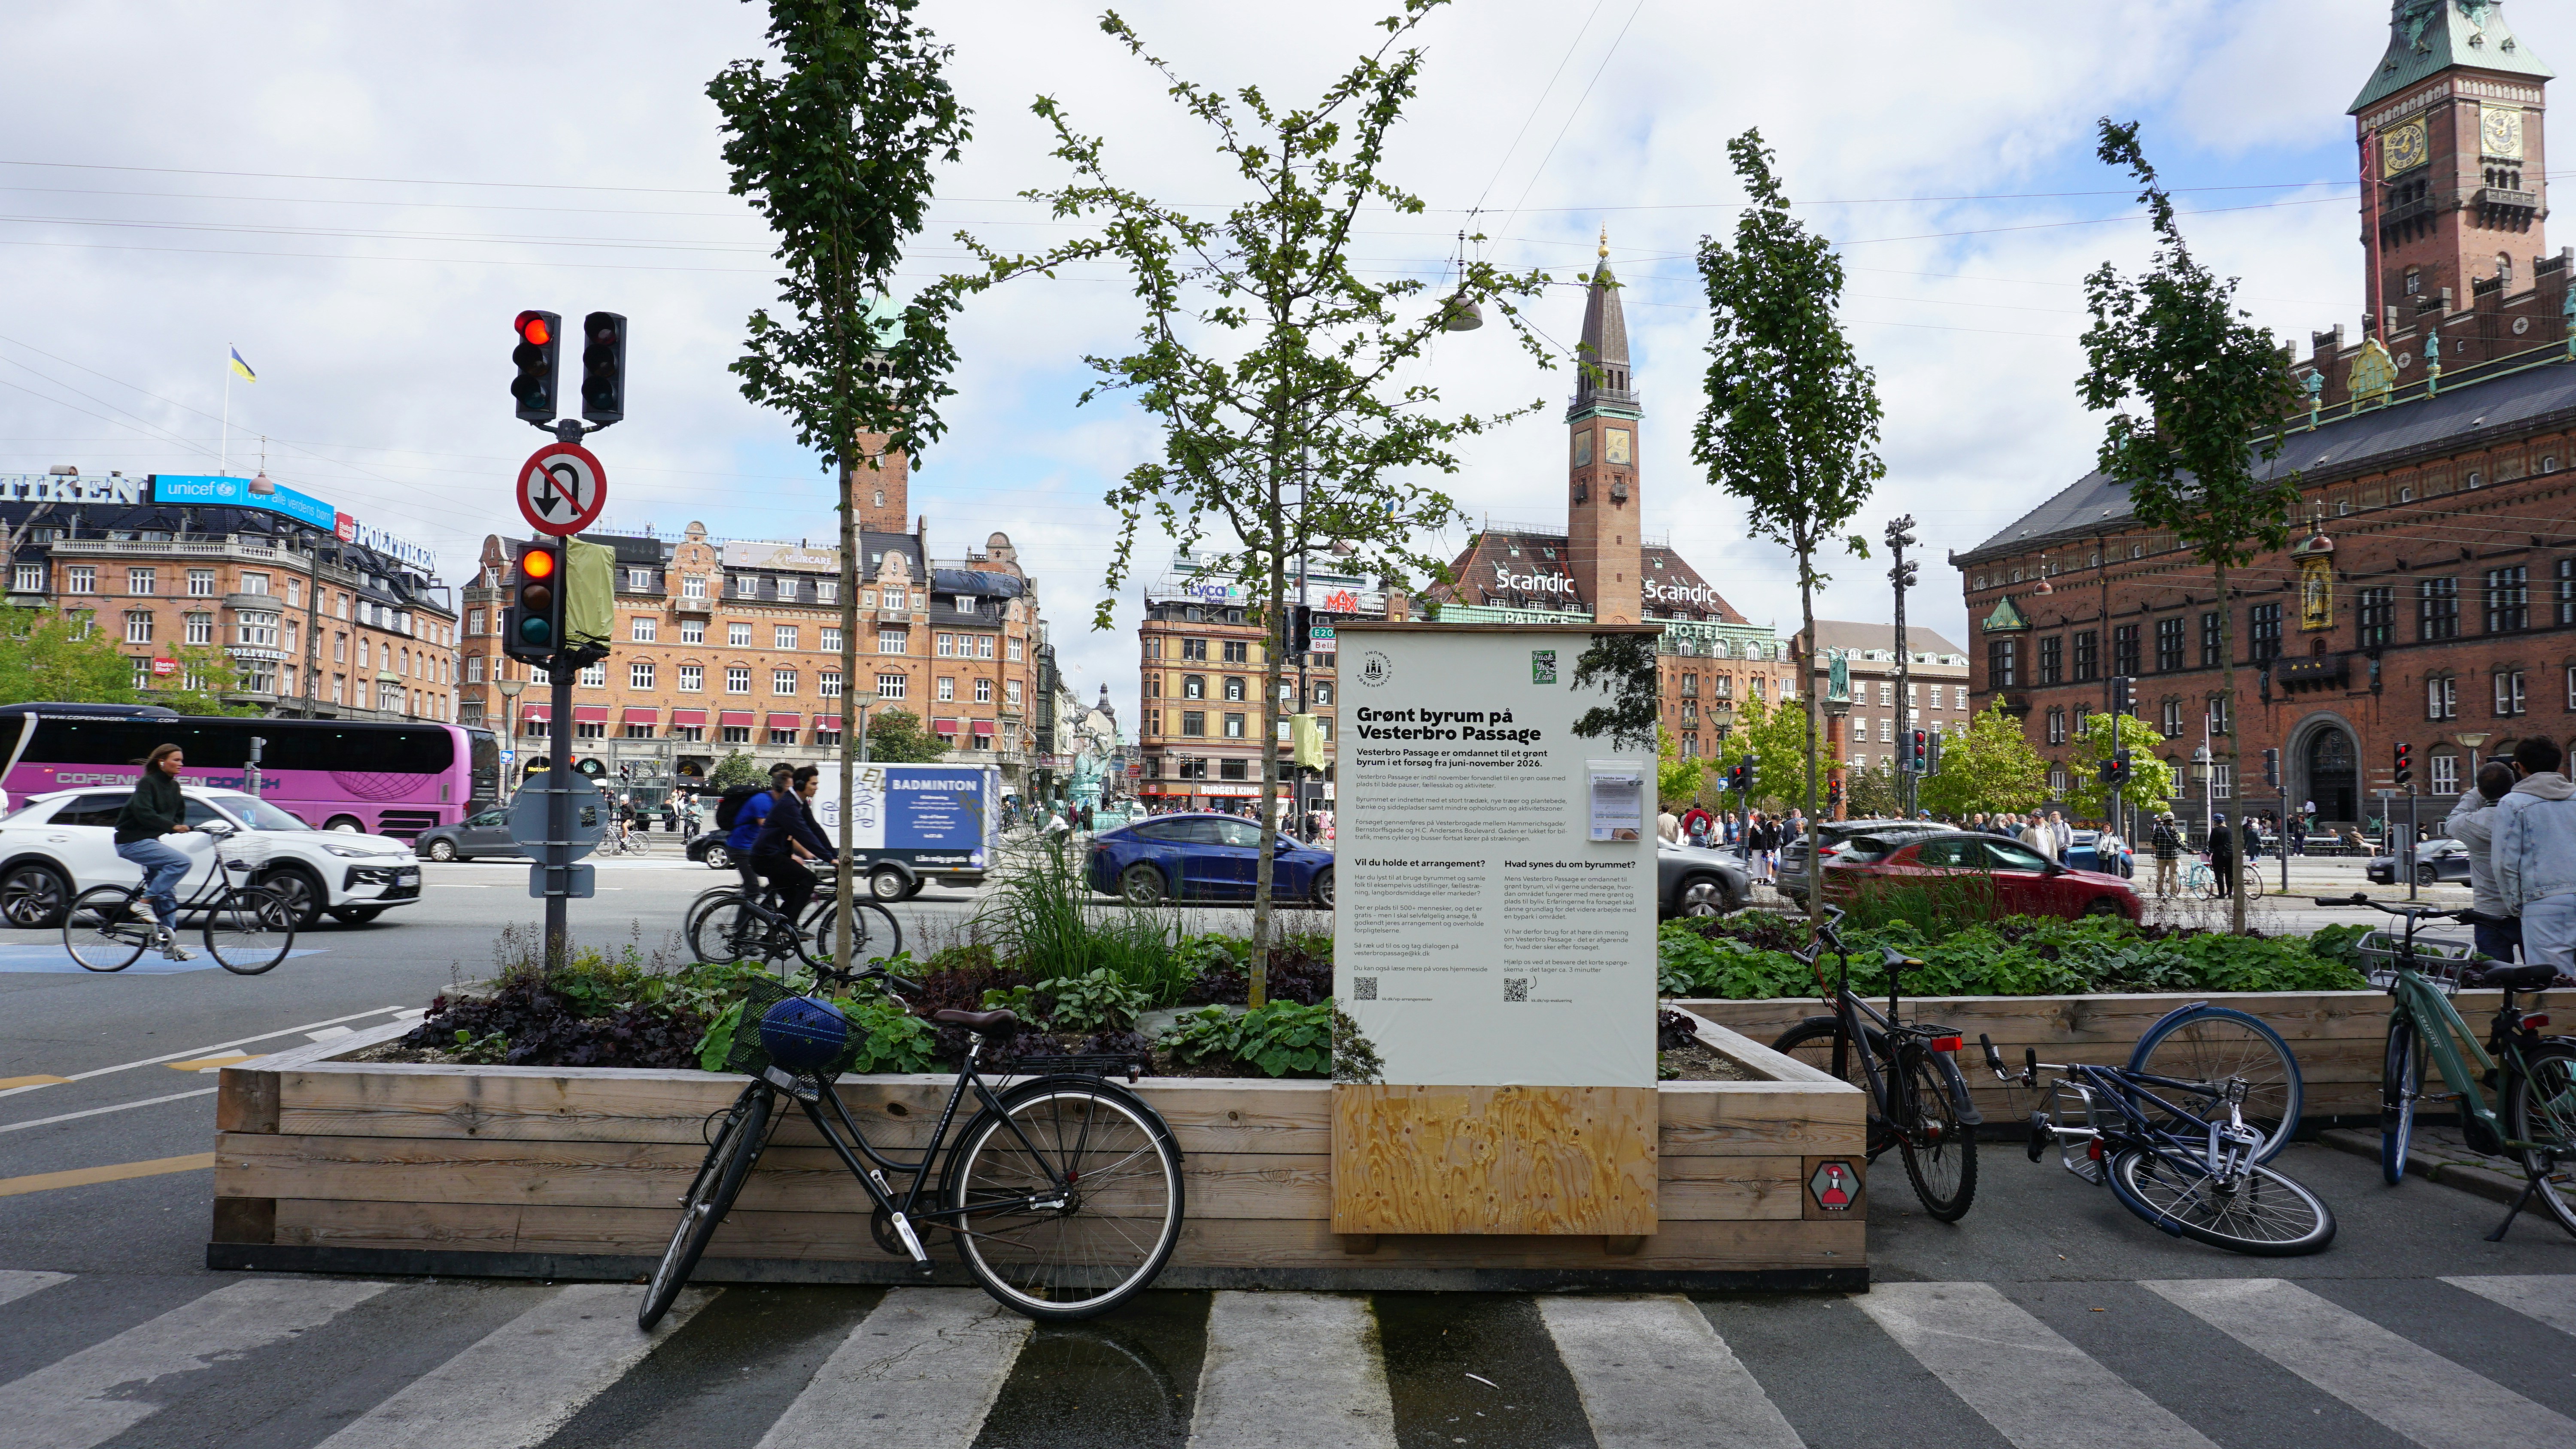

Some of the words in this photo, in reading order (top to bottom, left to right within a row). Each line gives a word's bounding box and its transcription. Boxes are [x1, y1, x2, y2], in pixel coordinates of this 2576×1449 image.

[167, 481, 215, 495] unicef
[272, 491, 286, 506] alle
[287, 498, 315, 516] verdens
[316, 505, 331, 522] børn
[339, 521, 352, 533] Ekstra
[358, 520, 439, 573] POLITIKEN
[785, 555, 832, 565] HAIRCARE
[1496, 569, 1575, 593] Scandic
[1190, 581, 1226, 597] Lyca
[1645, 580, 1717, 603] Scandic
[1326, 588, 1359, 613] MAX
[1505, 612, 1568, 624] PALACE
[1665, 622, 1723, 640] HOTEL
[1365, 651, 1392, 667] KOMMUNE
[1533, 651, 1554, 661] Fuck
[1534, 661, 1550, 670] the
[1357, 671, 1391, 688] KØBENHAVNS
[1534, 671, 1553, 681] Law
[1191, 687, 1197, 695] L
[1231, 689, 1237, 697] E
[1320, 693, 1326, 701] J
[39, 714, 179, 723] WWW.COPENHAGENCOACH.COM
[1357, 707, 1415, 722] Grønt
[1420, 708, 1484, 727] byrum
[1489, 708, 1513, 727] på
[1356, 724, 1457, 740] Vesterbro
[1463, 726, 1541, 746] Passage
[1403, 749, 1439, 758] Passage
[1522, 750, 1548, 759] grønt
[1357, 758, 1385, 768] byrum
[1403, 758, 1432, 769] forsøg
[1449, 759, 1515, 769] juni-november
[893, 779, 977, 791] BADMINTON
[1200, 785, 1236, 795] BURGER
[1237, 786, 1259, 796] KING
[1382, 858, 1408, 867] holde
[1421, 860, 1485, 869] arrangement?
[1528, 862, 1554, 870] synes
[1585, 860, 1636, 870] byrummet?
[935, 1087, 960, 1142] SKEPPSHULT
